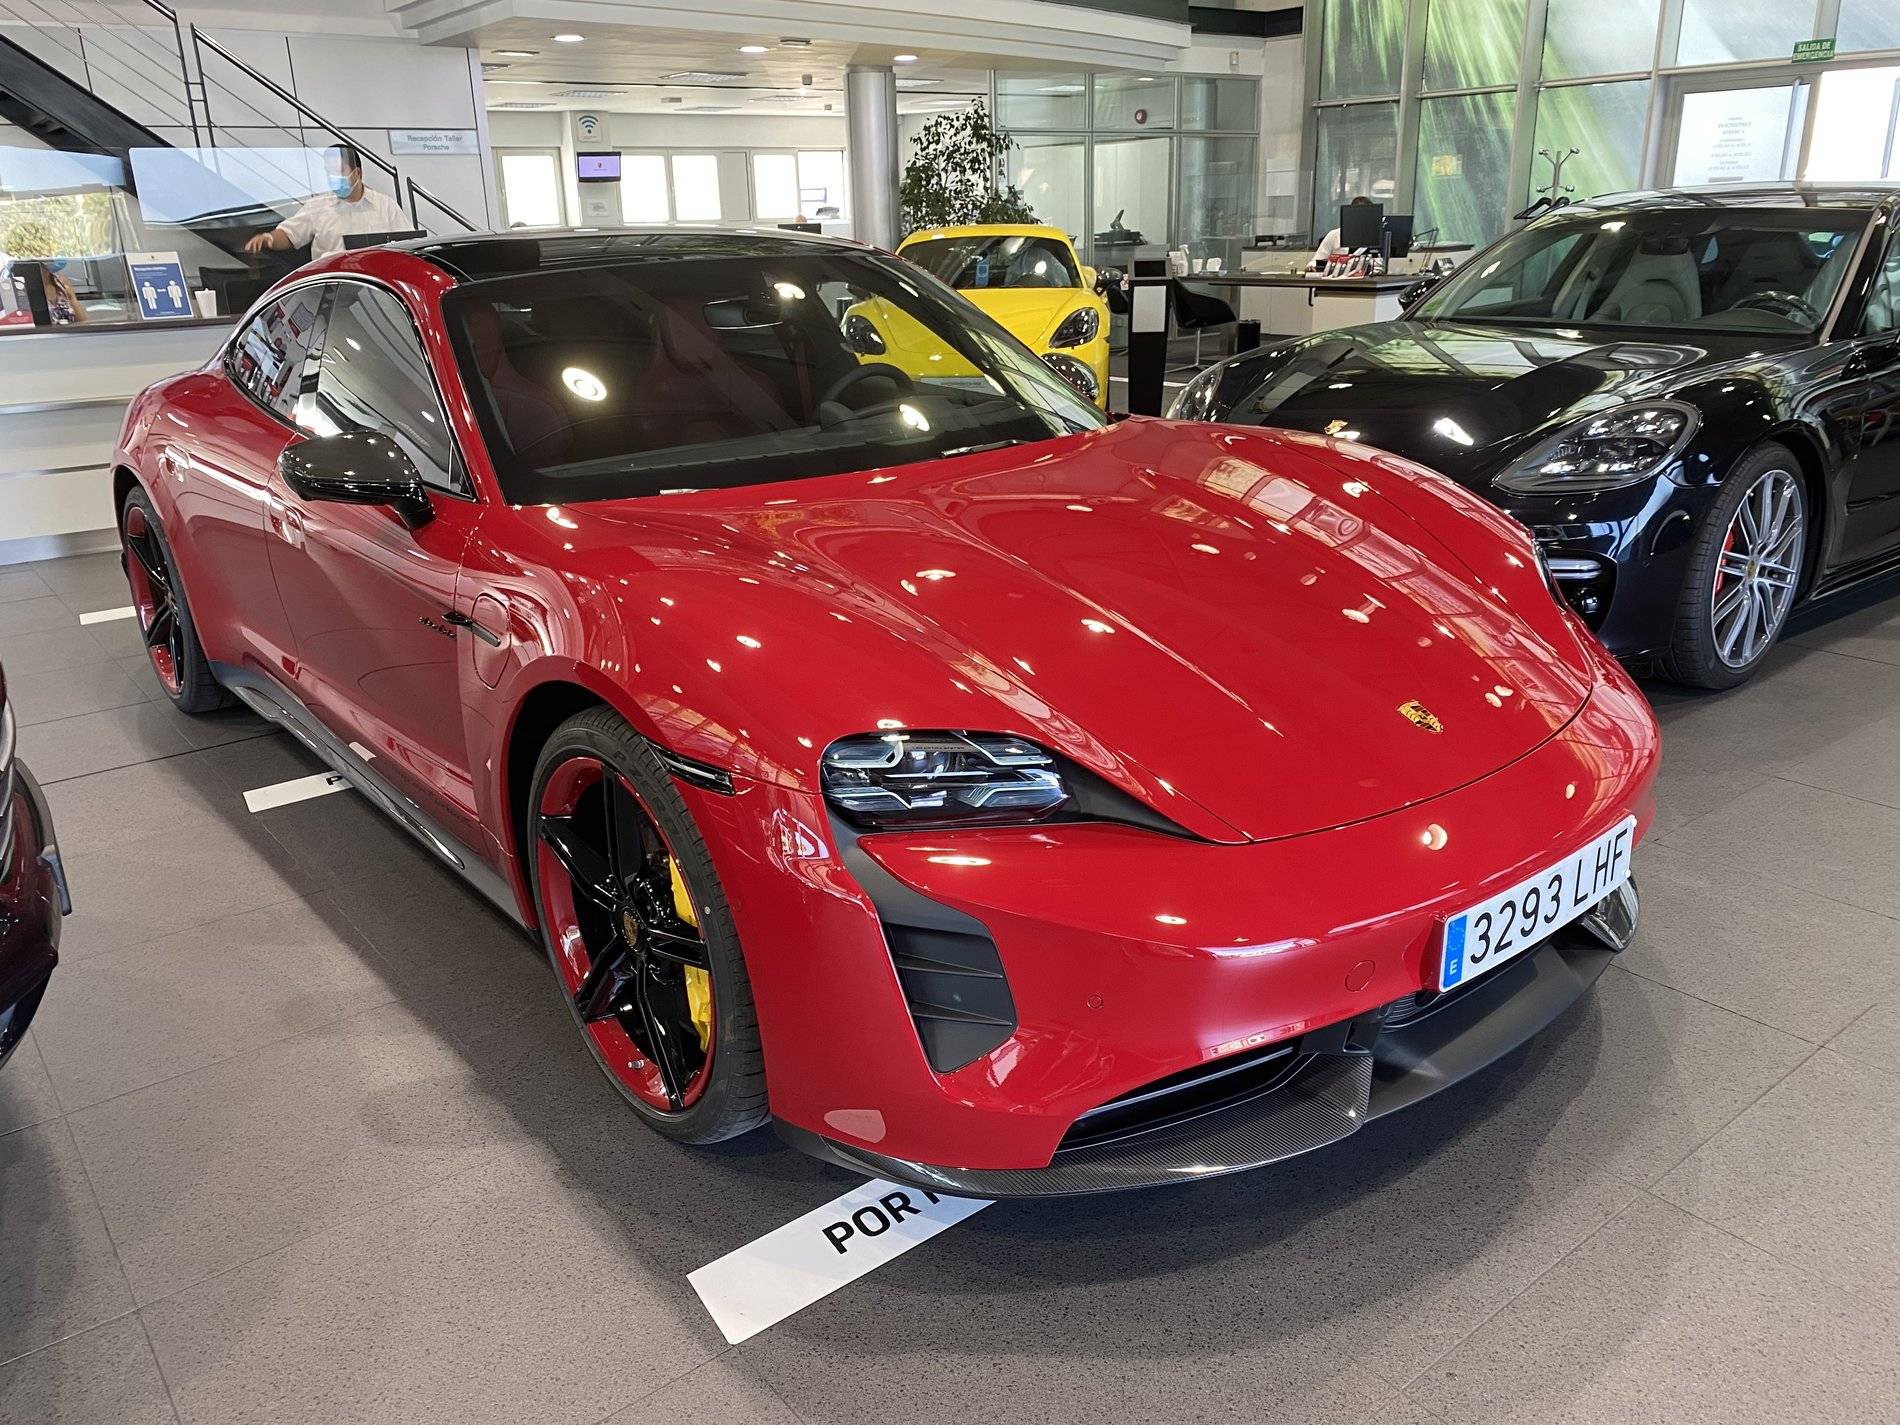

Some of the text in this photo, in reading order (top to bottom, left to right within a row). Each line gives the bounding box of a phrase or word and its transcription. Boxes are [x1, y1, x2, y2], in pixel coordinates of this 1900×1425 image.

[1798, 41, 1832, 51] SALIDA DE
[407, 135, 442, 143] Recepción
[1470, 828, 1628, 964] 3293 LHF
[1449, 959, 1458, 975] E
